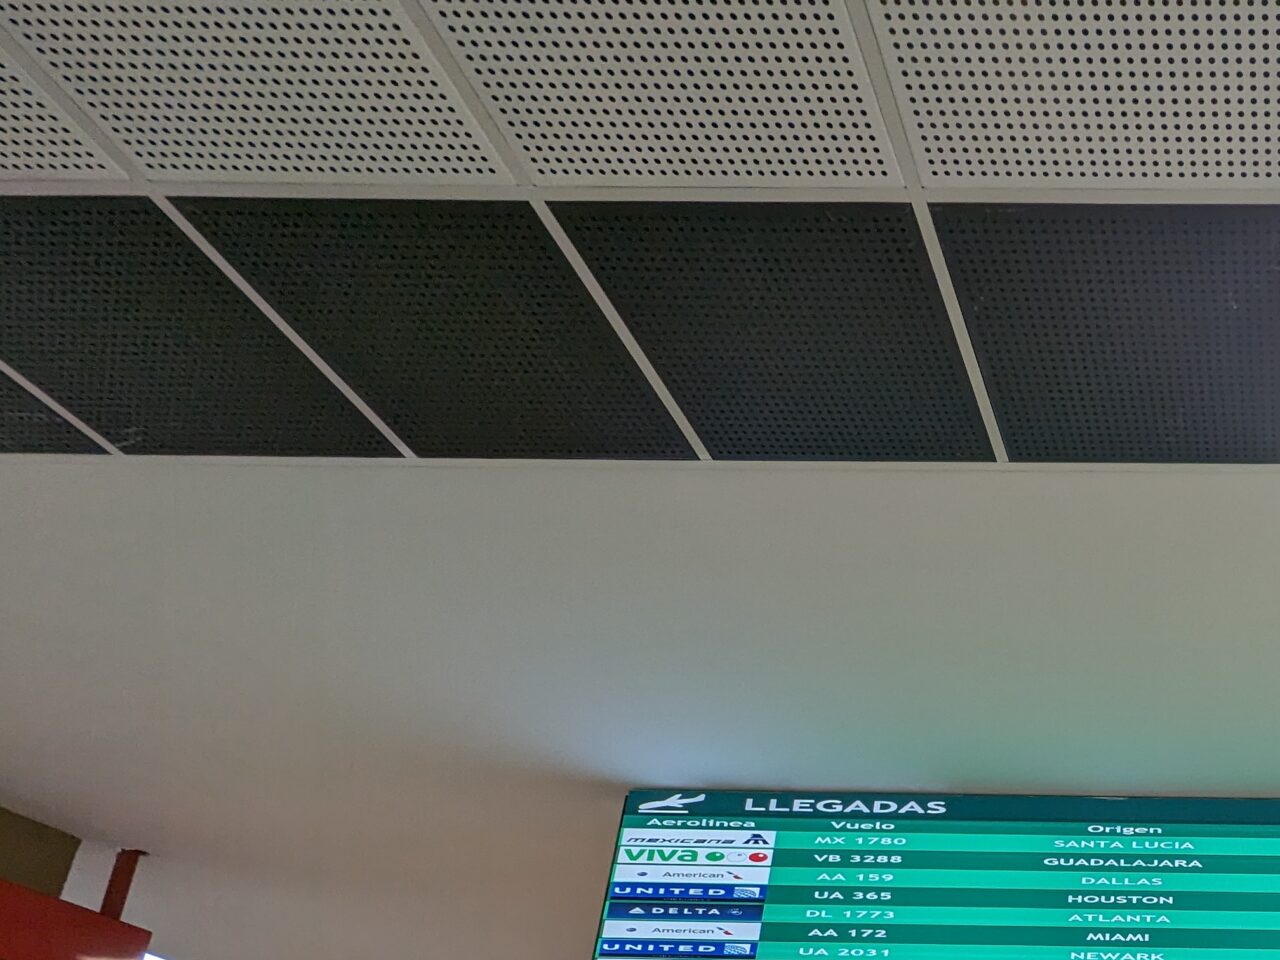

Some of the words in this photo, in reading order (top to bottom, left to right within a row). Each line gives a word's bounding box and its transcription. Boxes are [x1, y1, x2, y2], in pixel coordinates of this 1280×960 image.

[745, 797, 946, 815] LLEGADAS
[831, 820, 895, 831] Vuelo
[1088, 824, 1162, 836] Origen
[815, 835, 845, 845] MX
[856, 836, 906, 846] 1780
[1054, 839, 1123, 849] SANTA
[1132, 840, 1194, 850] LUCIA
[814, 854, 841, 863] VB
[850, 854, 902, 864] 3288
[1044, 857, 1203, 868] GUADALAJARA
[661, 870, 725, 879] American
[817, 872, 845, 881] AA
[856, 873, 893, 882] 159
[1082, 876, 1162, 886] DALLAS
[614, 886, 726, 896] UNITED
[814, 890, 844, 900] UA
[853, 891, 891, 901] 365
[1068, 894, 1173, 905] HOUSTON
[652, 906, 721, 915] DELTA
[806, 909, 832, 918] DL
[844, 910, 894, 919] 1773
[1068, 913, 1170, 924] ATLANTA
[651, 926, 715, 935] American
[808, 928, 838, 937] AA
[848, 928, 887, 938] 172
[1086, 932, 1149, 942] MIAMI
[602, 943, 716, 953] UNITED
[799, 947, 828, 956] UA
[838, 948, 889, 957] 2031
